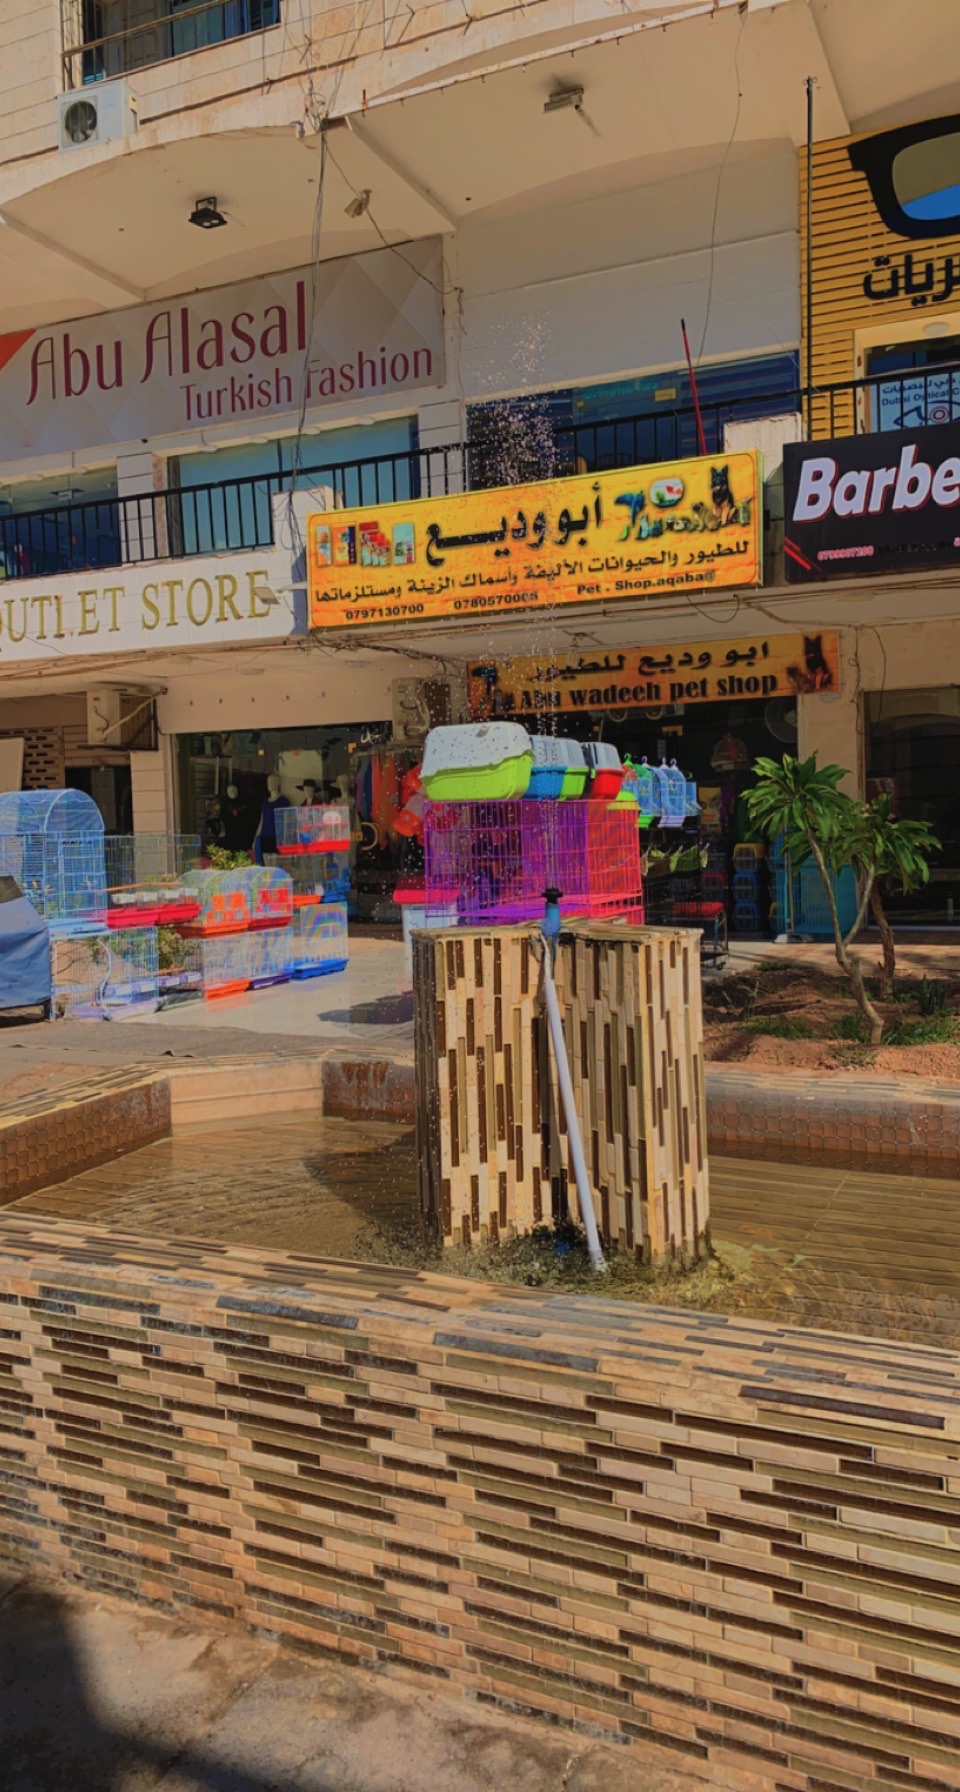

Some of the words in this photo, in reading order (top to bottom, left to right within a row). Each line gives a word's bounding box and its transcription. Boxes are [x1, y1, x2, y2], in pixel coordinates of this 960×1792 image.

[863, 254, 960, 307] ريات
[26, 333, 124, 405] Abu
[140, 281, 307, 384] Alasal
[180, 368, 293, 421] Turkish
[305, 345, 434, 399] Fashion
[554, 481, 603, 546] أبو
[426, 510, 548, 567] وديع
[588, 550, 679, 573] والحيوانات
[684, 540, 749, 565] للطيور
[459, 566, 518, 587] وأسماك
[523, 558, 584, 584] الأليفة
[315, 585, 402, 602] ومستلزماتها
[407, 577, 455, 594] الزينة
[577, 583, 600, 595] Pet
[0, 586, 125, 643] UTLET
[141, 569, 272, 631] STORE
[345, 603, 424, 620] 0797130700
[637, 651, 712, 676] وديع
[720, 641, 770, 668] ابو
[669, 677, 708, 702] pet
[716, 674, 777, 697] shop
